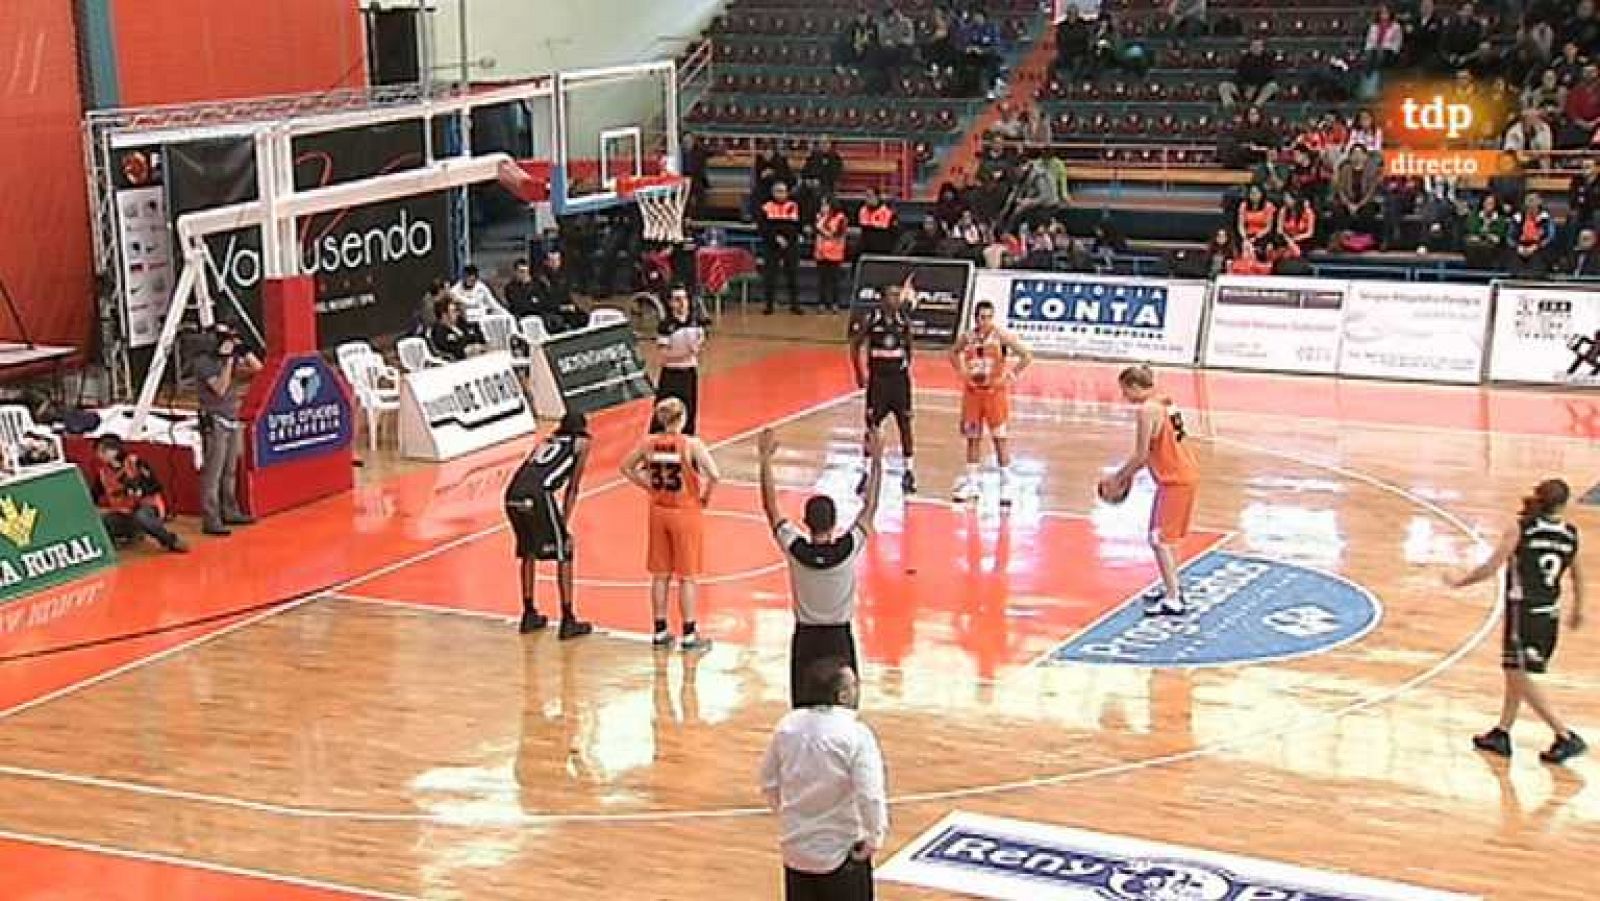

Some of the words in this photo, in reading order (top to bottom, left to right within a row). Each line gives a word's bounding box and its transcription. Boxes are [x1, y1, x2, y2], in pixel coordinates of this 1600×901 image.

[1014, 297, 1161, 326] CONTA
[649, 462, 683, 491] 33
[21, 535, 103, 577] RURAL
[942, 836, 1106, 876] Reny
